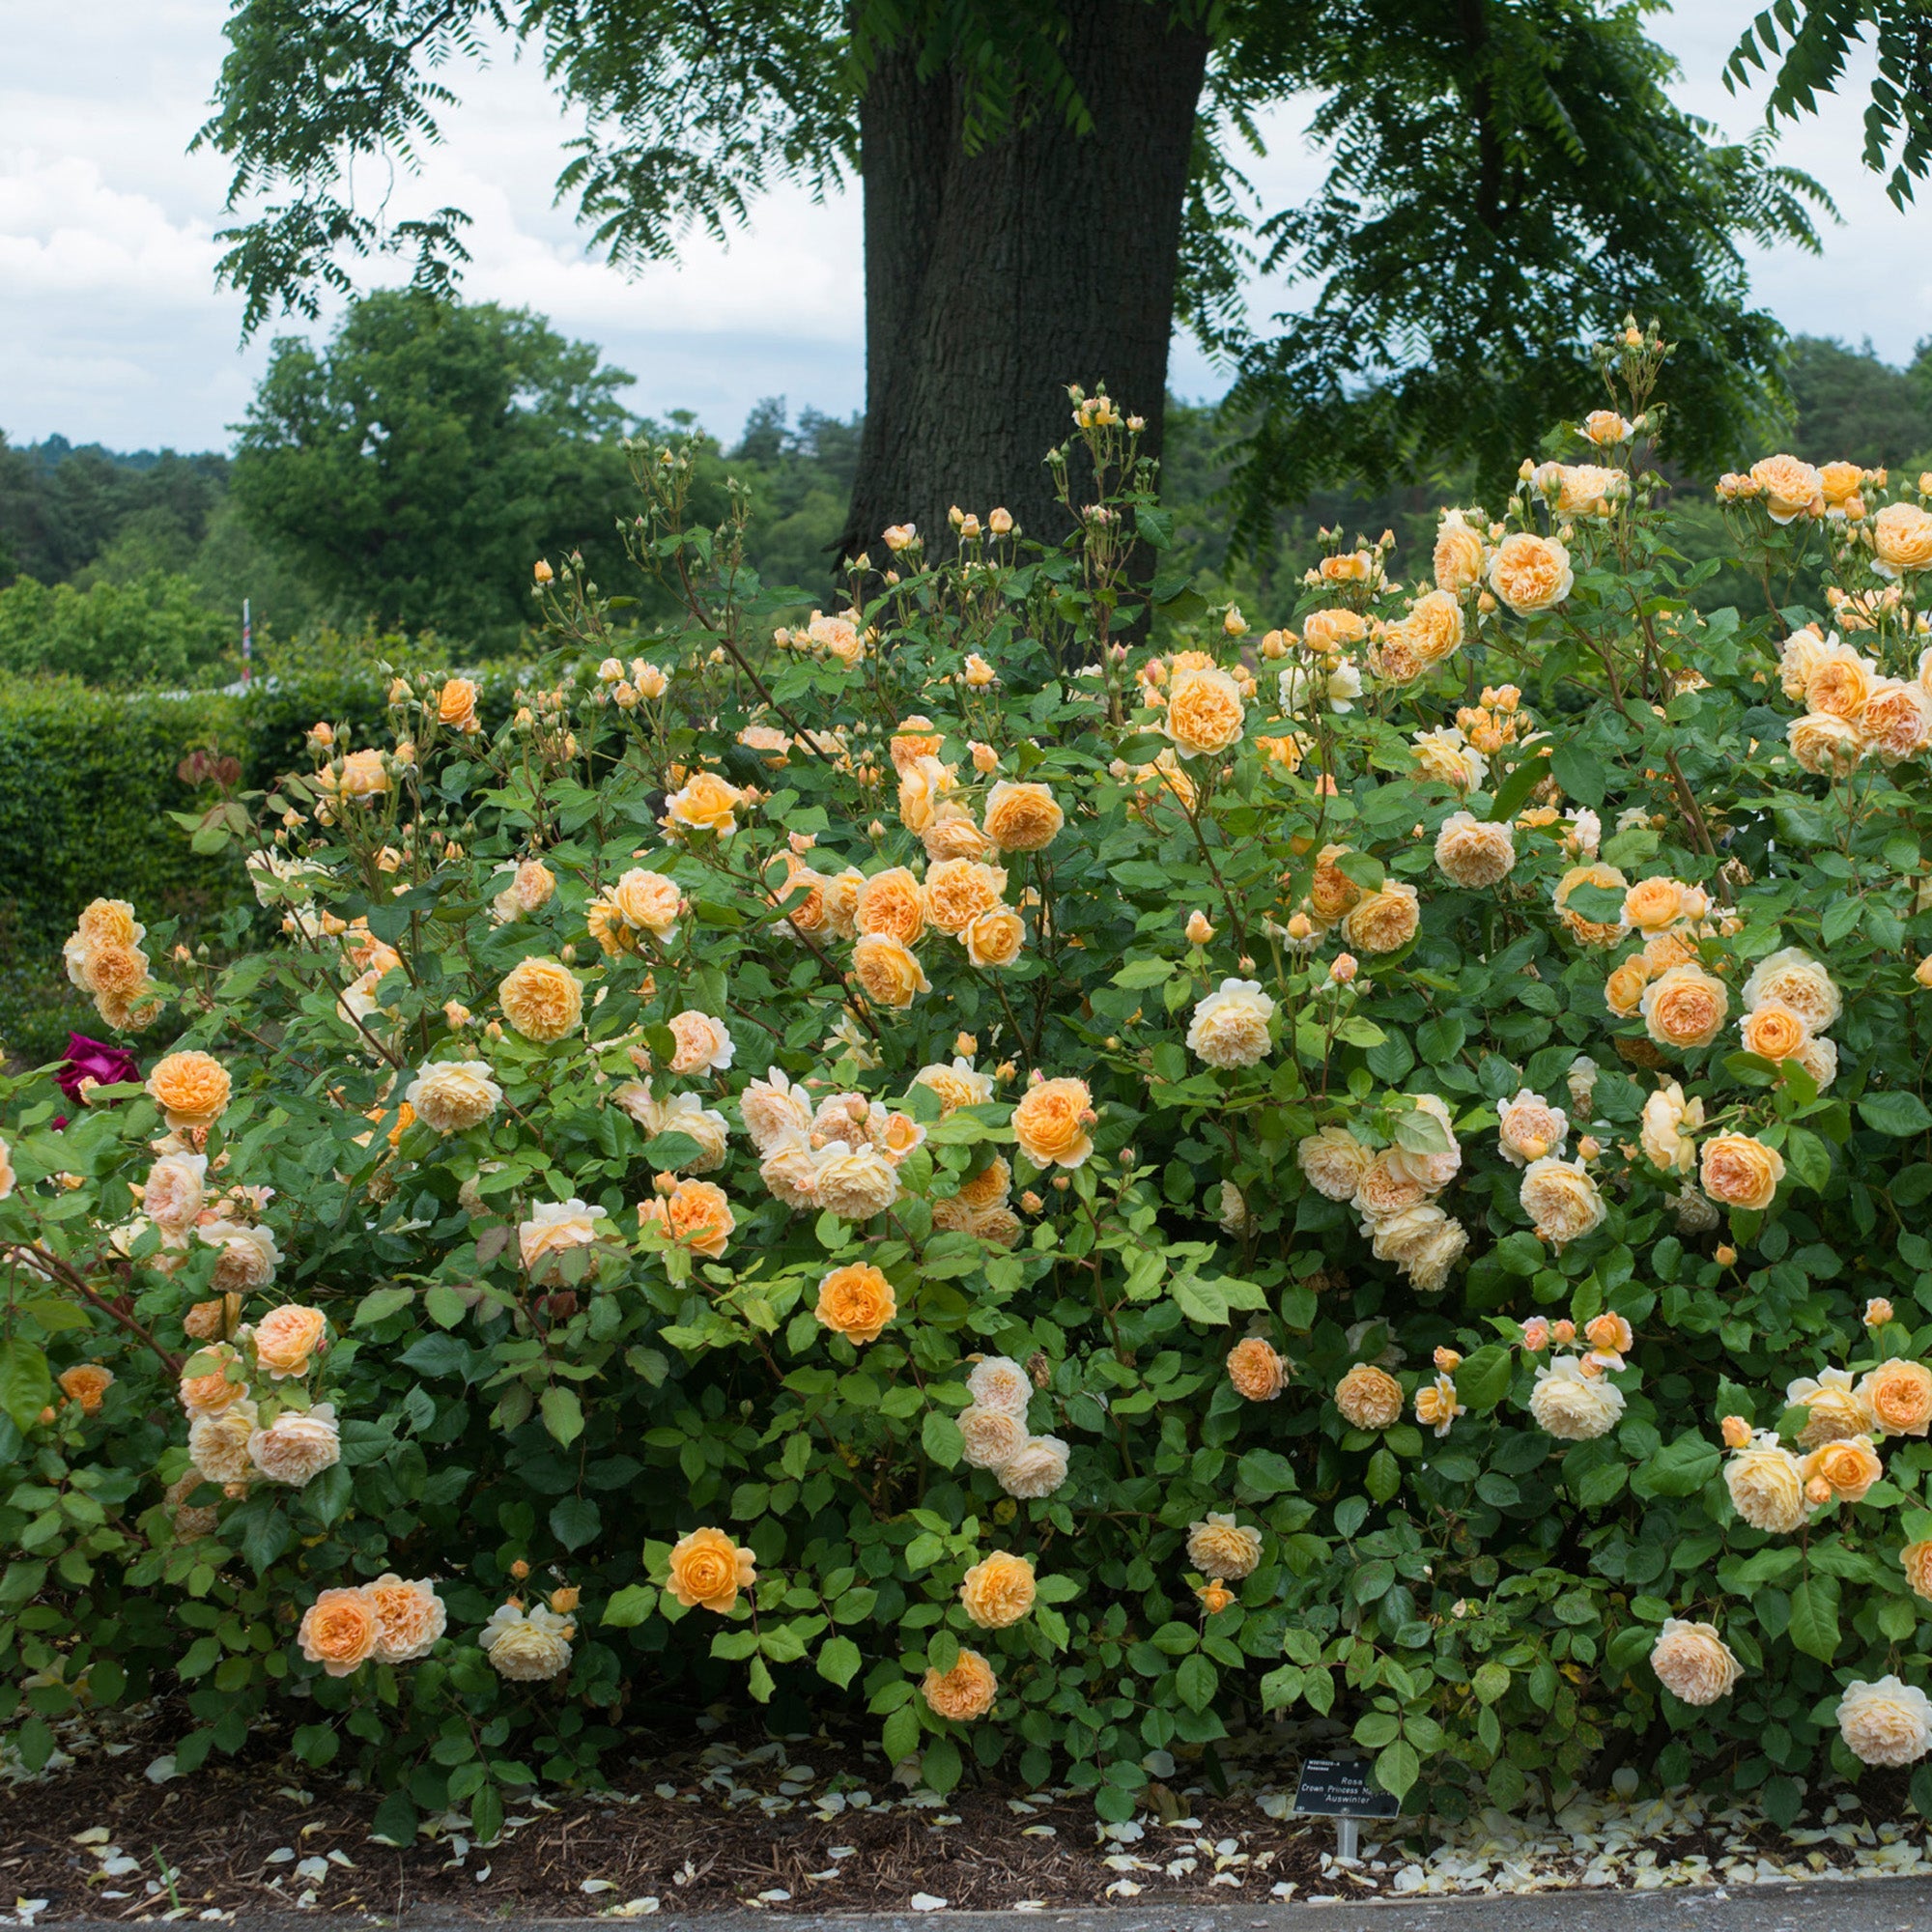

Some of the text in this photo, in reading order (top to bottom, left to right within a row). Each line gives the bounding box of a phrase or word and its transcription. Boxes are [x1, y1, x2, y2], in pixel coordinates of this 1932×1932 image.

[1341, 1776, 1363, 1786] Rosa
[1301, 1783, 1324, 1792] Crown
[1327, 1784, 1358, 1795] Princess
